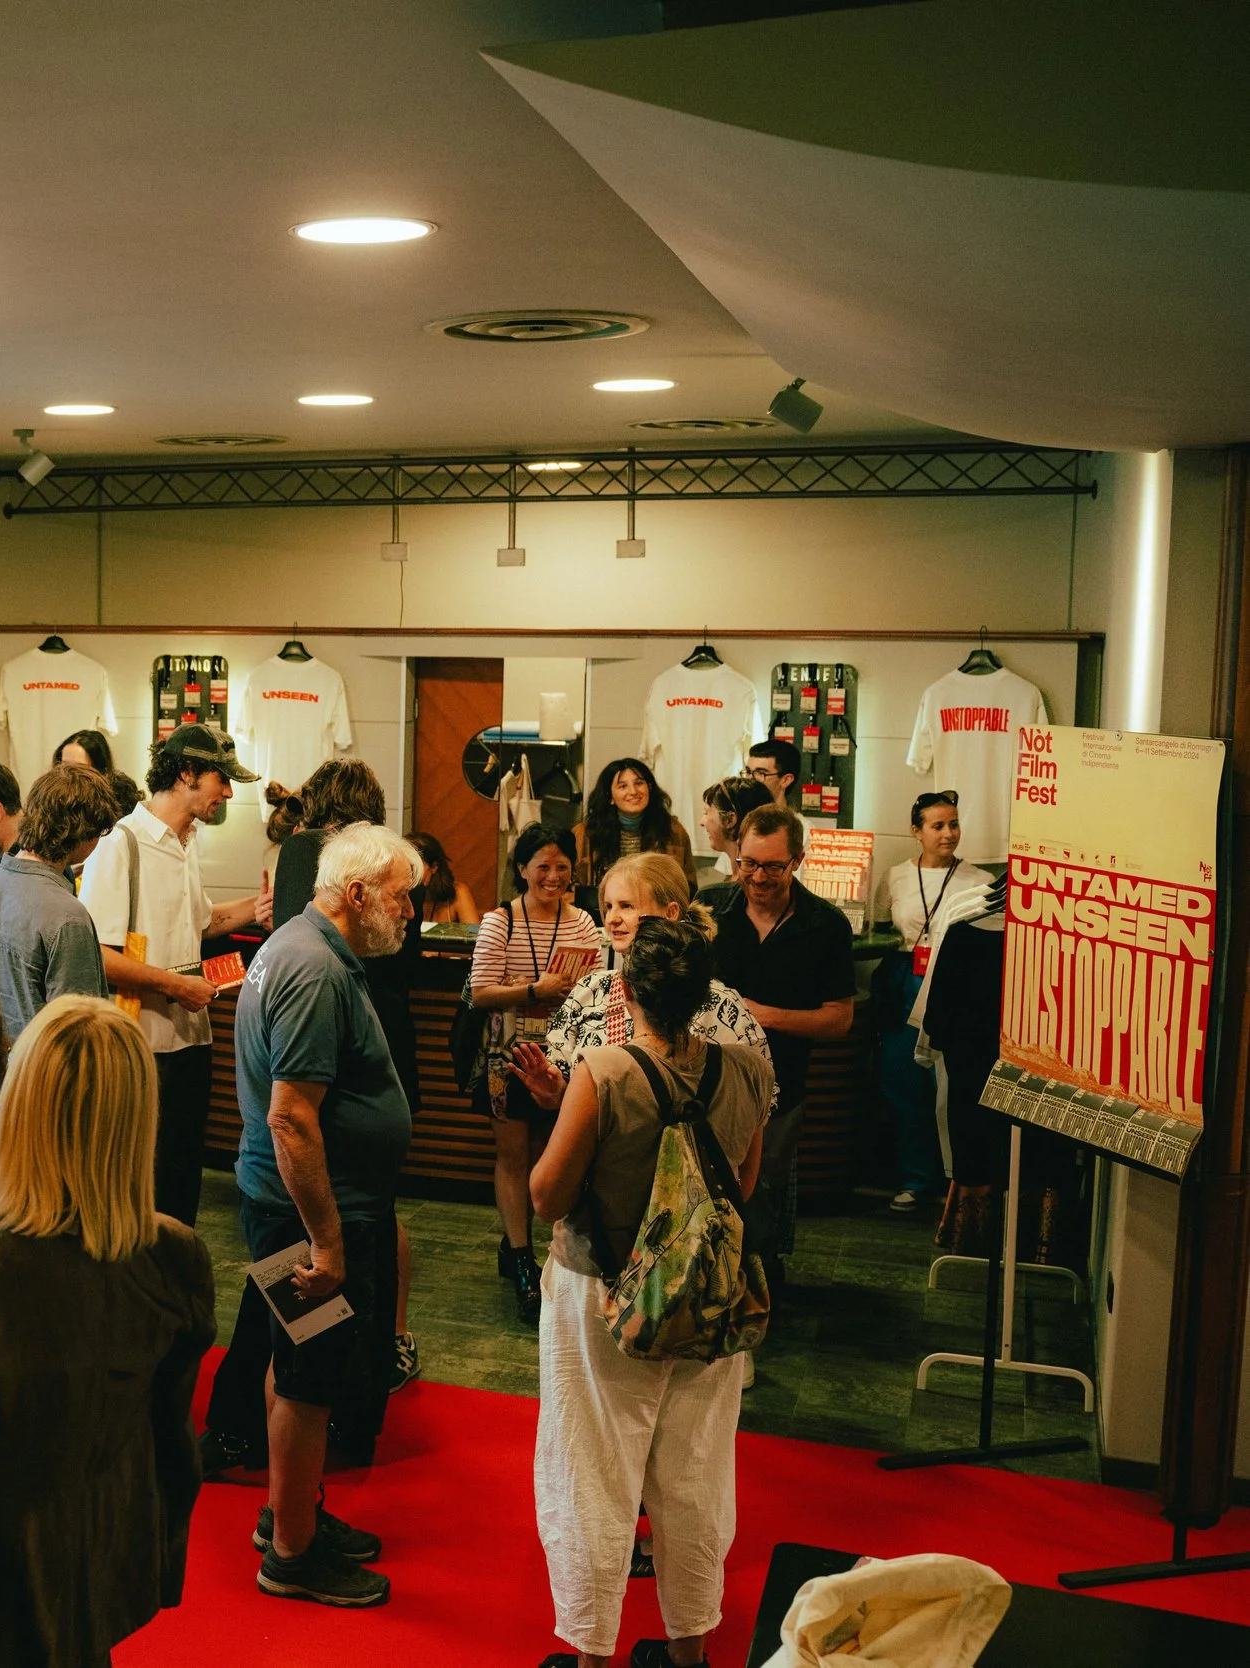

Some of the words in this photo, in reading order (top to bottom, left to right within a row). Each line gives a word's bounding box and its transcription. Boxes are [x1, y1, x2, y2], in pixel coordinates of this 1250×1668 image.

[23, 682, 80, 691] UNTAMED
[262, 691, 318, 703] UNSEEN
[666, 698, 724, 708] UNTAMED
[940, 707, 1010, 732] UNSTOPPABLE
[1020, 727, 1053, 754] Nòt
[1082, 733, 1105, 742] Festival
[1018, 752, 1058, 779] Film
[1151, 747, 1183, 758] Settembre
[1184, 751, 1199, 760] 2024
[1015, 777, 1058, 806] Fest
[1011, 858, 1212, 918] UNTAMED
[1010, 885, 1210, 961] UNSEEN
[1003, 921, 1210, 1114] UNSTOPPABLE
